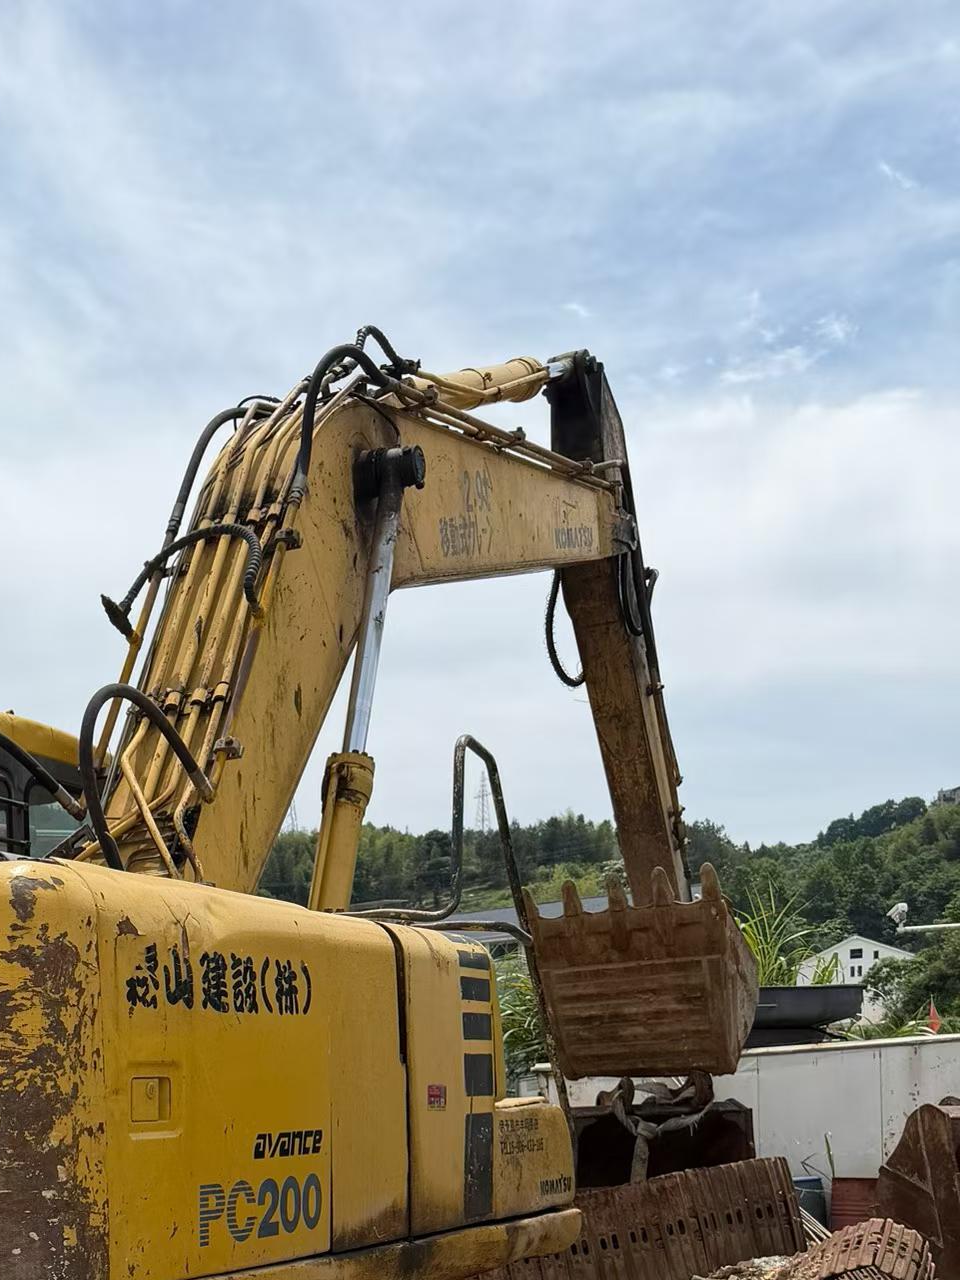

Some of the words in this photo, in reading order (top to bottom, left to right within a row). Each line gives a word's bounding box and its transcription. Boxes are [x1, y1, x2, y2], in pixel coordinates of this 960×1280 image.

[253, 1129, 323, 1160] avance
[540, 1174, 572, 1197] KOMATSU
[199, 1173, 323, 1247] PC200
